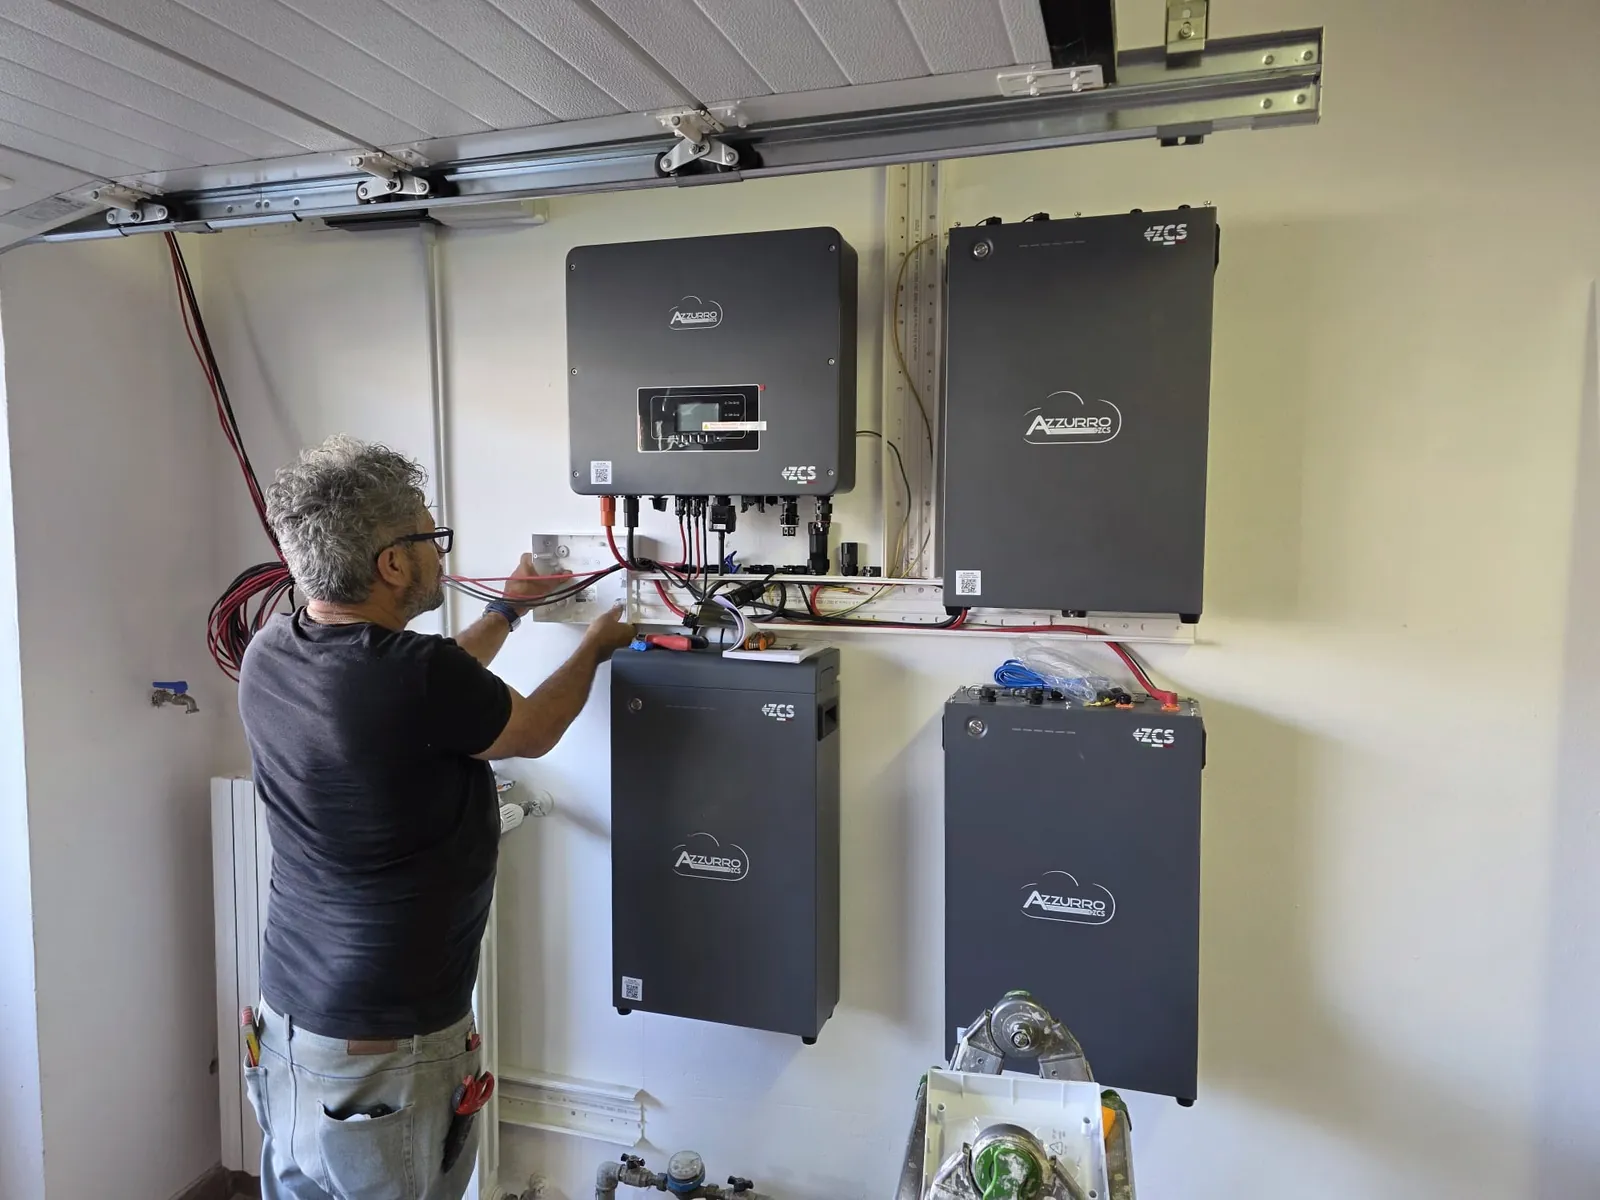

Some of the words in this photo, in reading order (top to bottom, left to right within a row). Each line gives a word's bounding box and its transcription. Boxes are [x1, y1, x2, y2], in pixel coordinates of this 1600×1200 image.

[1152, 223, 1187, 241] ZCS
[670, 311, 718, 324] AZZURRO
[1025, 415, 1112, 435] AZZURRO
[788, 466, 817, 480] ZCS
[768, 703, 795, 718] ZCS
[1141, 727, 1175, 744] ZCS
[674, 851, 742, 868] AZZURRO
[1022, 890, 1106, 910] AZZURRO
